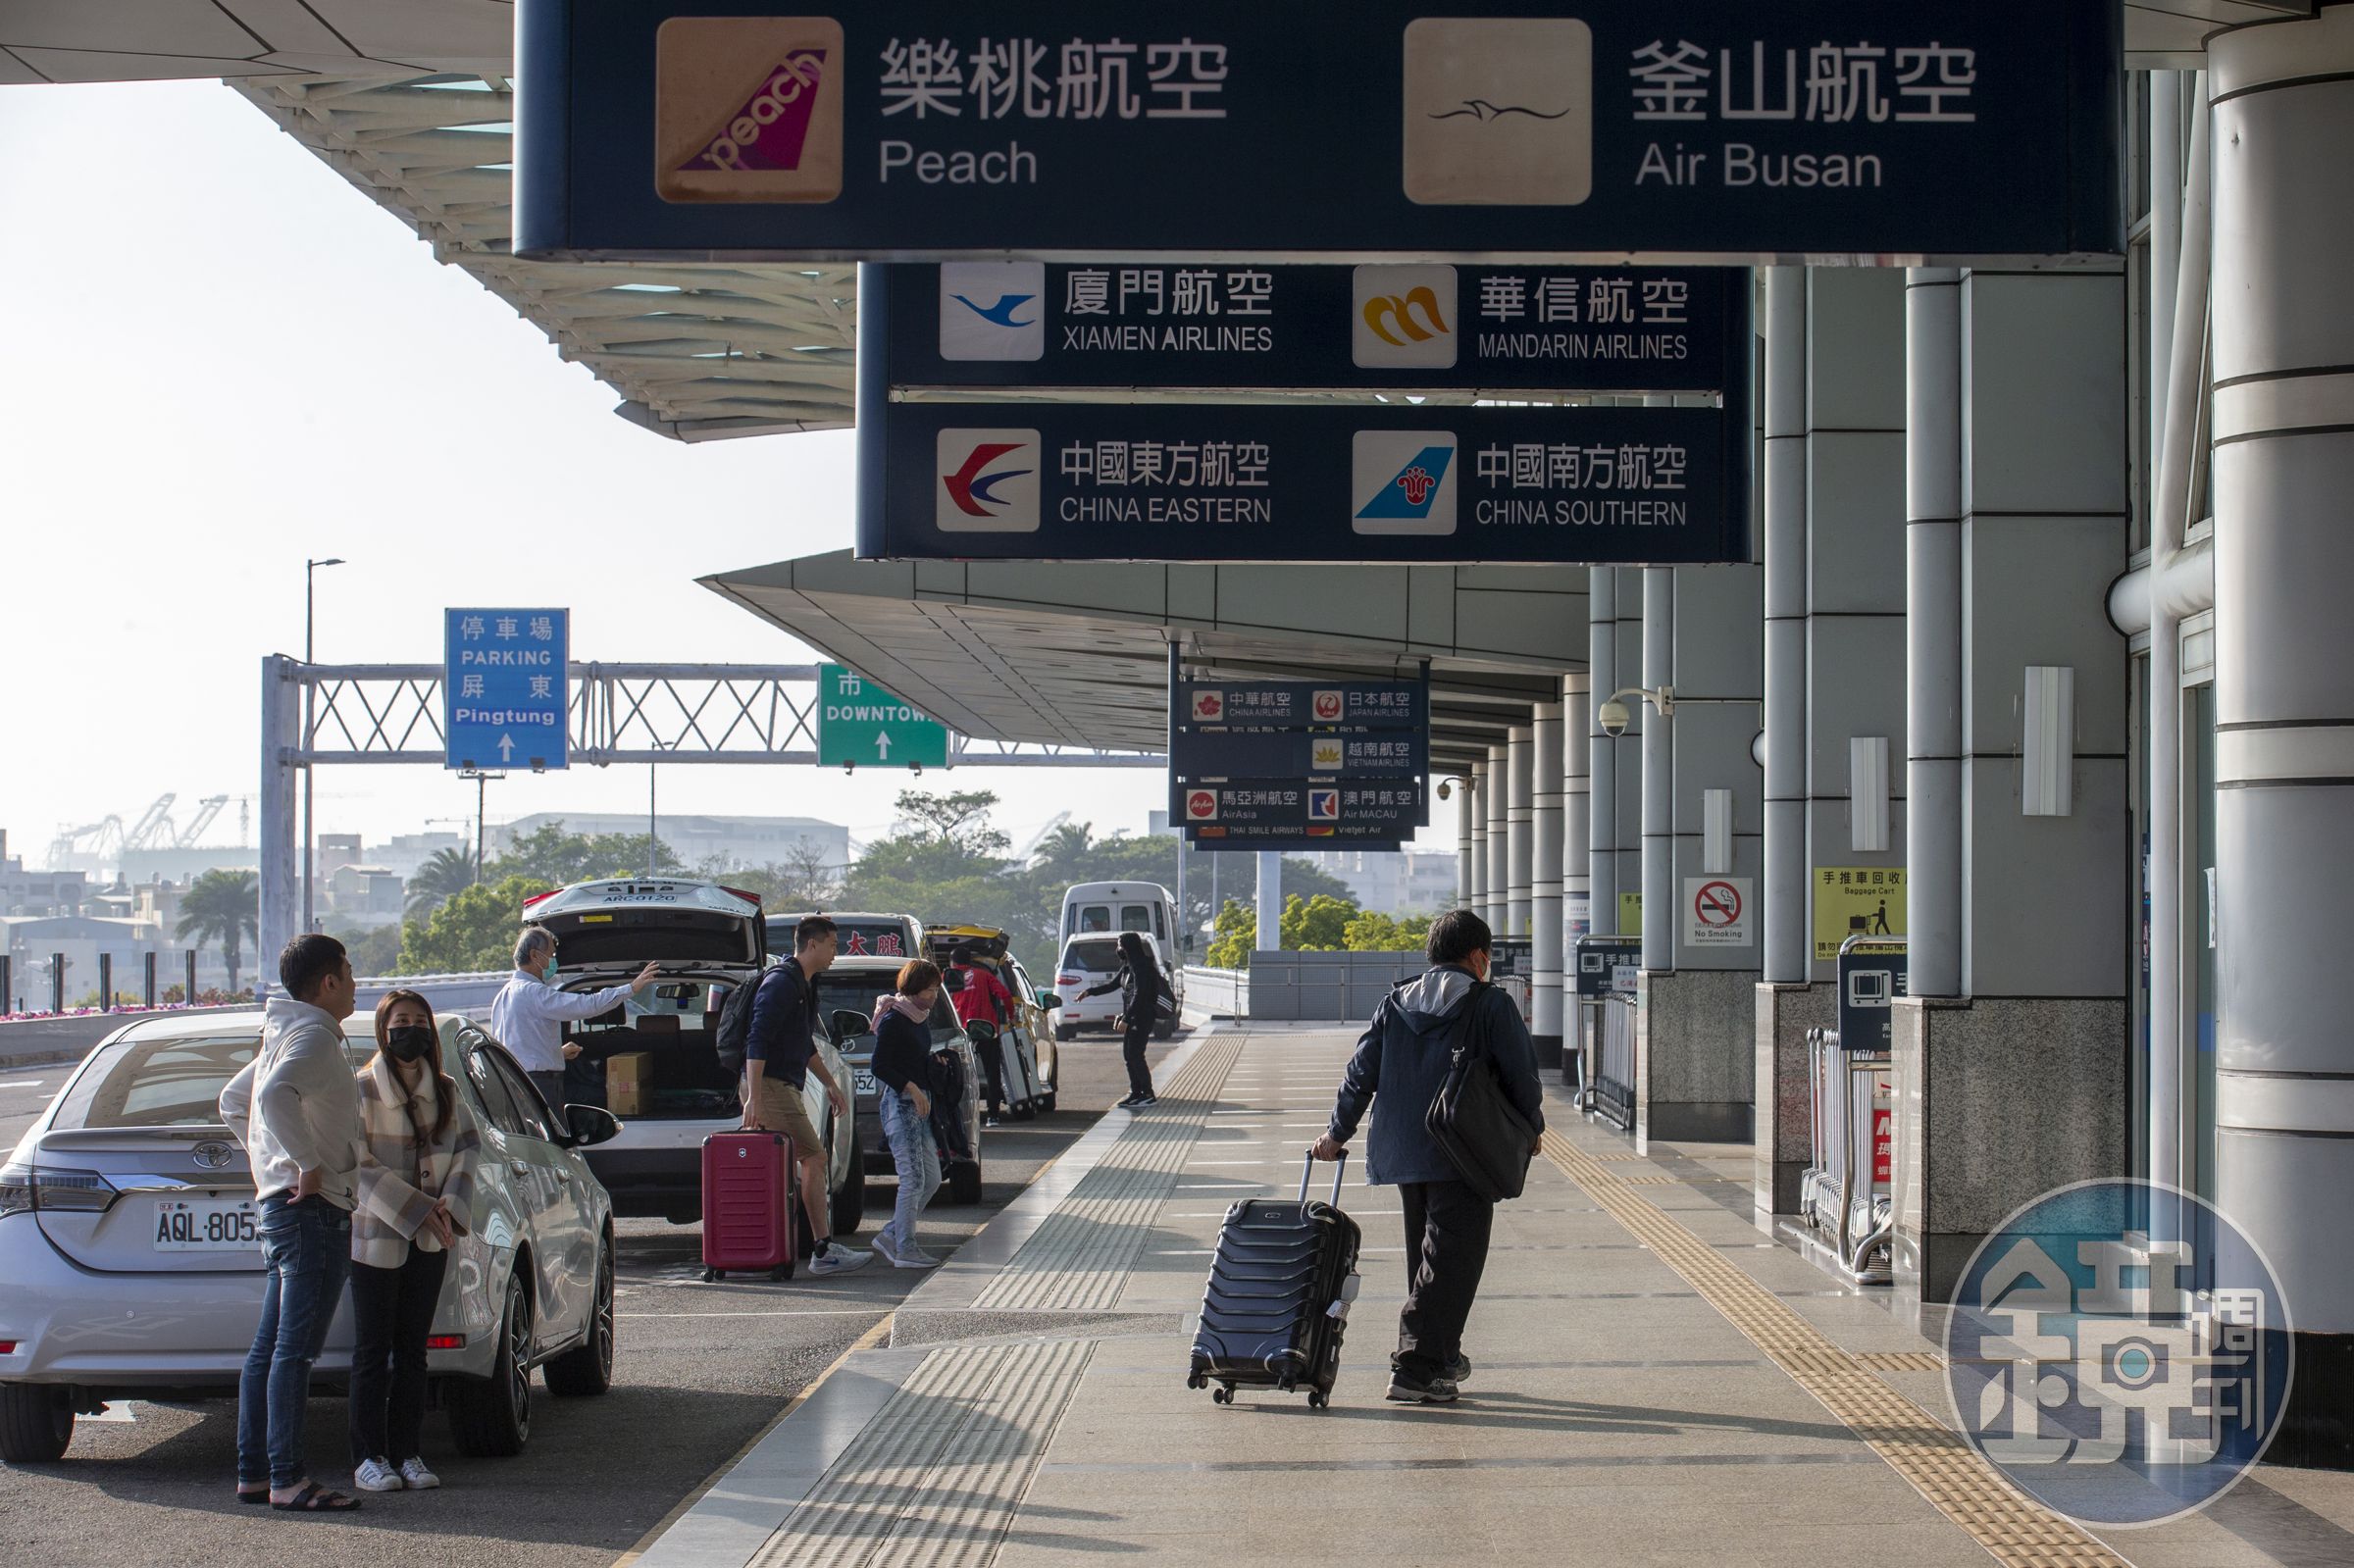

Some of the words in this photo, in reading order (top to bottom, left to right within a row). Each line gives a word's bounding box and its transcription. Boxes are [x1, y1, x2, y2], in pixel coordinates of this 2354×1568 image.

[880, 37, 1228, 121] 樂桃航空
[1629, 39, 1976, 124] 釜山航空
[700, 50, 826, 172] peach
[881, 141, 1037, 184] Peach
[1635, 143, 1706, 186] Air
[1724, 143, 1881, 187] Busan
[1064, 269, 1273, 316] 廈門航空
[1479, 276, 1688, 324] 華信航空
[1062, 326, 1155, 351] XIAMEN
[1161, 326, 1273, 352] AIRLINES
[1478, 334, 1588, 359] MANDARIN
[1593, 334, 1688, 360] AIRLINES
[1060, 440, 1270, 487] 中國東方航空
[1476, 442, 1686, 490] 中國南方航空
[1059, 497, 1141, 523] CHINA
[1149, 497, 1271, 523] EASTERN
[1476, 500, 1549, 526] CHINA
[1555, 500, 1686, 526] SOUTHERN
[460, 615, 553, 640] 停車場
[461, 650, 551, 665] PARKING
[460, 674, 552, 699] 屏東
[838, 670, 861, 695] 市
[1229, 691, 1291, 706] 中華航空
[1349, 691, 1410, 706] 日本航空
[455, 708, 555, 726] Pingtung
[1229, 708, 1254, 717] CHINA
[1254, 708, 1292, 717] AIRLINES
[1348, 708, 1373, 717] JAPAN
[1374, 708, 1410, 717] AIRLINES
[1348, 742, 1410, 756] 越南航空
[1222, 790, 1298, 805] 馬亞洲航空
[1343, 790, 1411, 805] 澳門航空
[1221, 809, 1257, 819] AirAsia
[1343, 809, 1357, 819] Air
[1358, 809, 1398, 819] MACAU
[1823, 871, 1907, 885] 手推車回收
[844, 930, 903, 958] 大鵬
[157, 1212, 261, 1242] AQL-805
